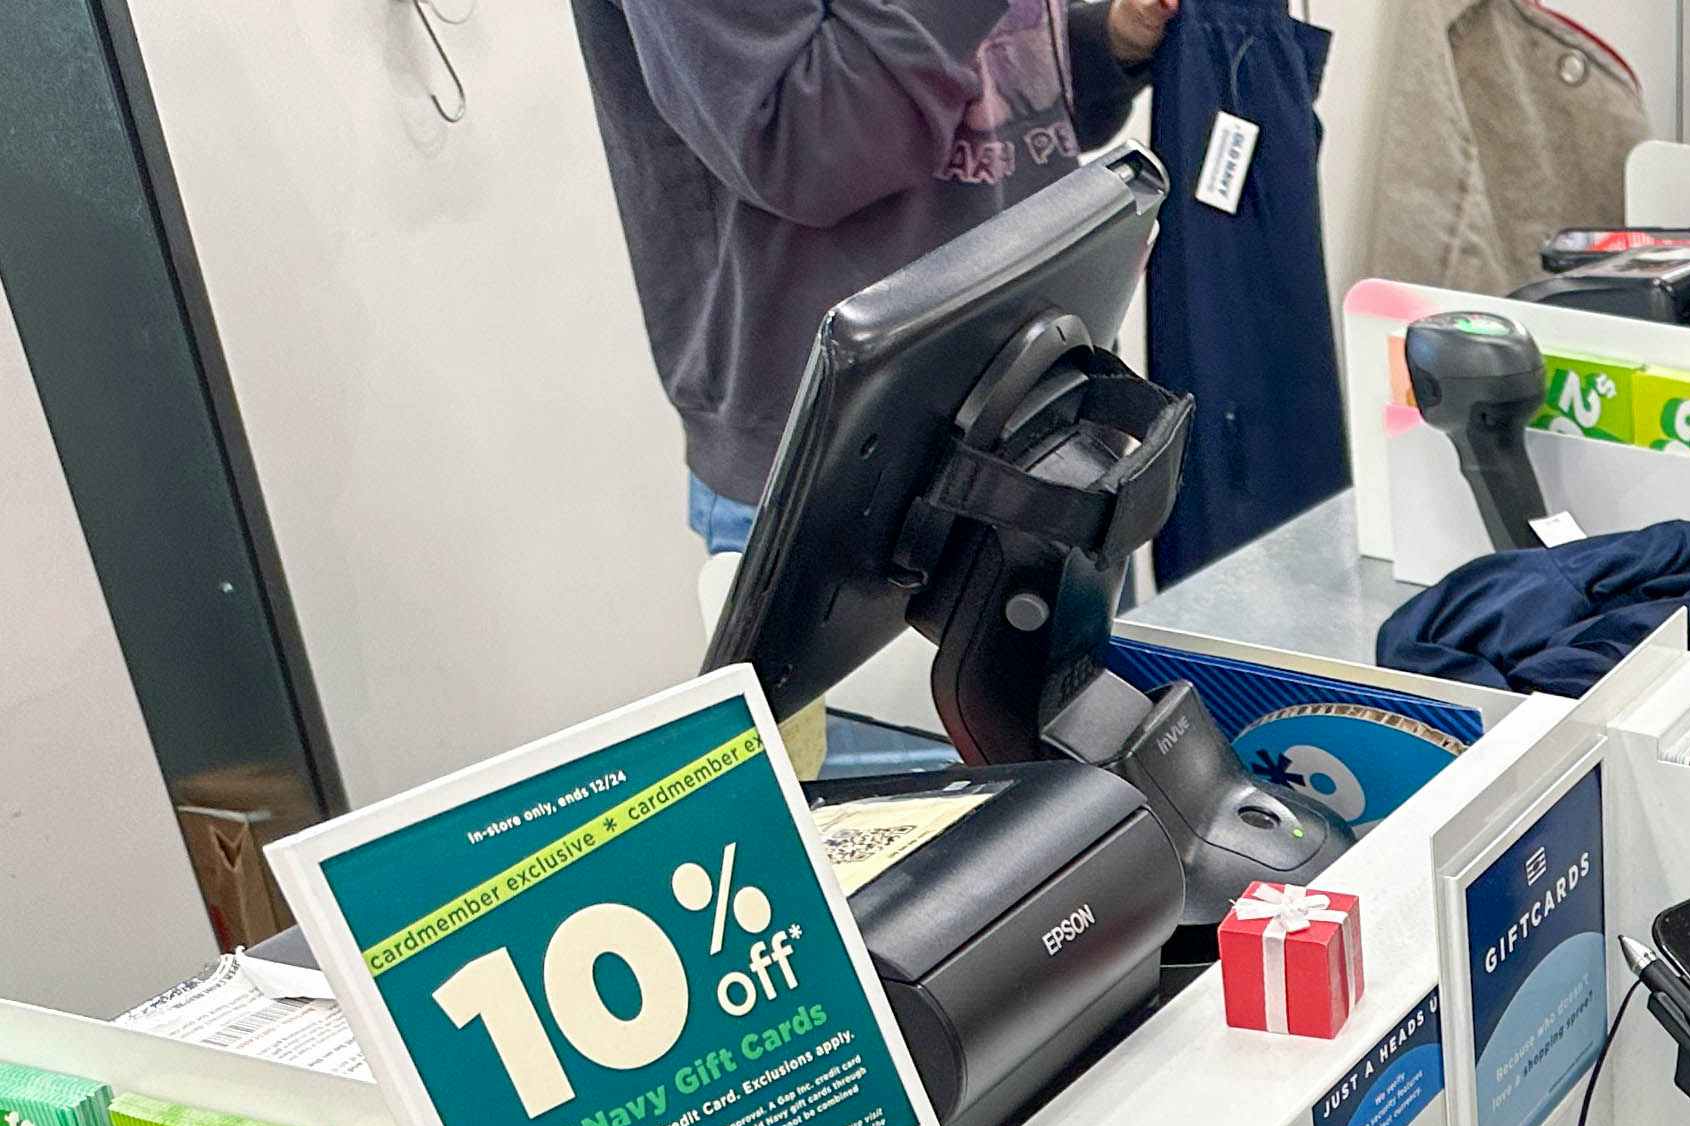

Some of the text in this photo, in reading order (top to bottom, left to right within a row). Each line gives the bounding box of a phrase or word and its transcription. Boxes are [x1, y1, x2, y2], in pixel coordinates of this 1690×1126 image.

[467, 770, 625, 843] In-store only, ends 12/24
[370, 886, 498, 968] cardmember
[507, 833, 594, 890] exclusive
[628, 748, 737, 819] cardmember
[1042, 904, 1096, 956] EPSON
[1486, 852, 1588, 972] GIFTCARDS
[675, 1048, 736, 1093] Gift
[741, 1004, 826, 1059] Cards
[703, 1089, 739, 1114] Card.
[742, 1051, 812, 1093] Exclusions
[816, 1030, 853, 1055] apply.
[777, 1091, 795, 1104] Gap
[796, 1083, 813, 1094] Inc.
[815, 1066, 840, 1084] credit
[842, 1055, 860, 1070] card
[1324, 1010, 1423, 1117] JUST A HEADS
[1523, 1018, 1565, 1081] shopping
[765, 1109, 787, 1125] Navy
[790, 1099, 805, 1113] gift
[808, 1086, 831, 1102] cards
[832, 1067, 865, 1089] through
[803, 1109, 814, 1119] be
[817, 1084, 858, 1111] combined
